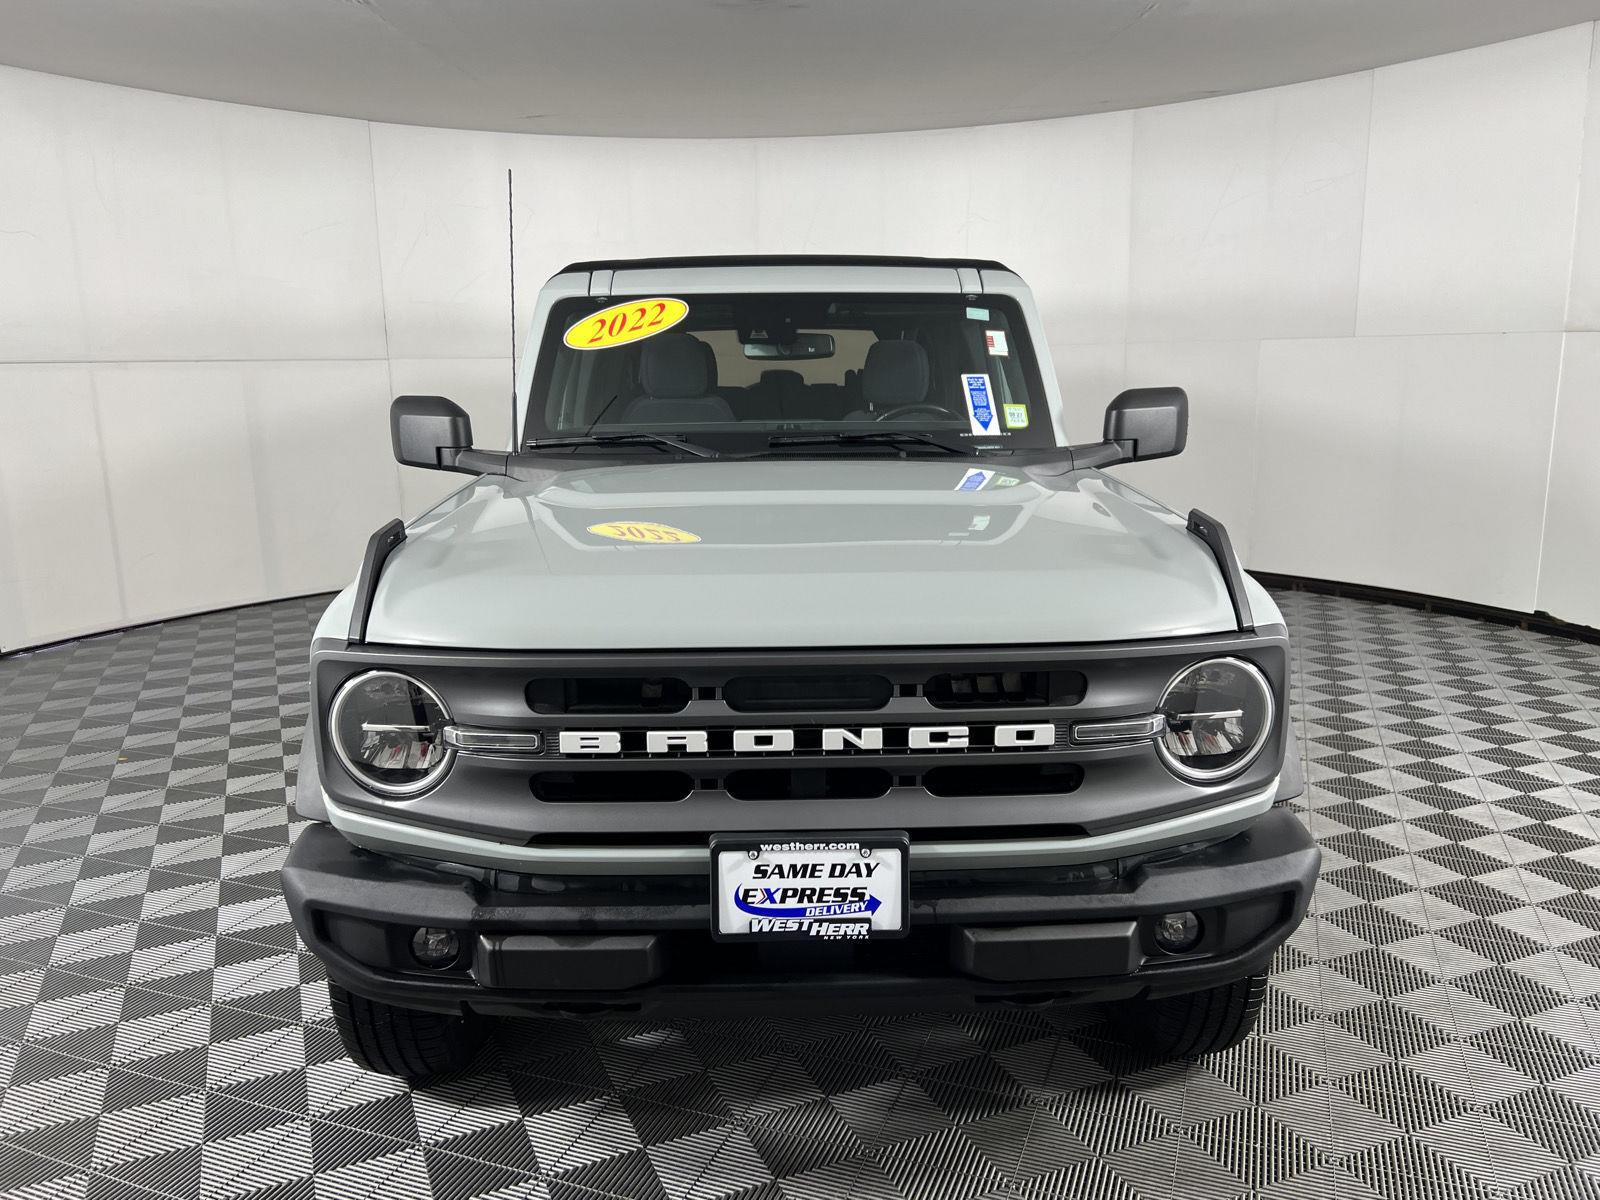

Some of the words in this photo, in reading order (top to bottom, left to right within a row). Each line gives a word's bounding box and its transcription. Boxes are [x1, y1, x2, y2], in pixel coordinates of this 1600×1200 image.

[587, 302, 666, 344] 2022
[559, 724, 1055, 754] BRONCO
[760, 842, 860, 851] westherr.com
[752, 864, 825, 879] SAME
[828, 862, 880, 878] DAY
[741, 887, 868, 905] EXPRESS
[805, 901, 868, 917] DELIVERY
